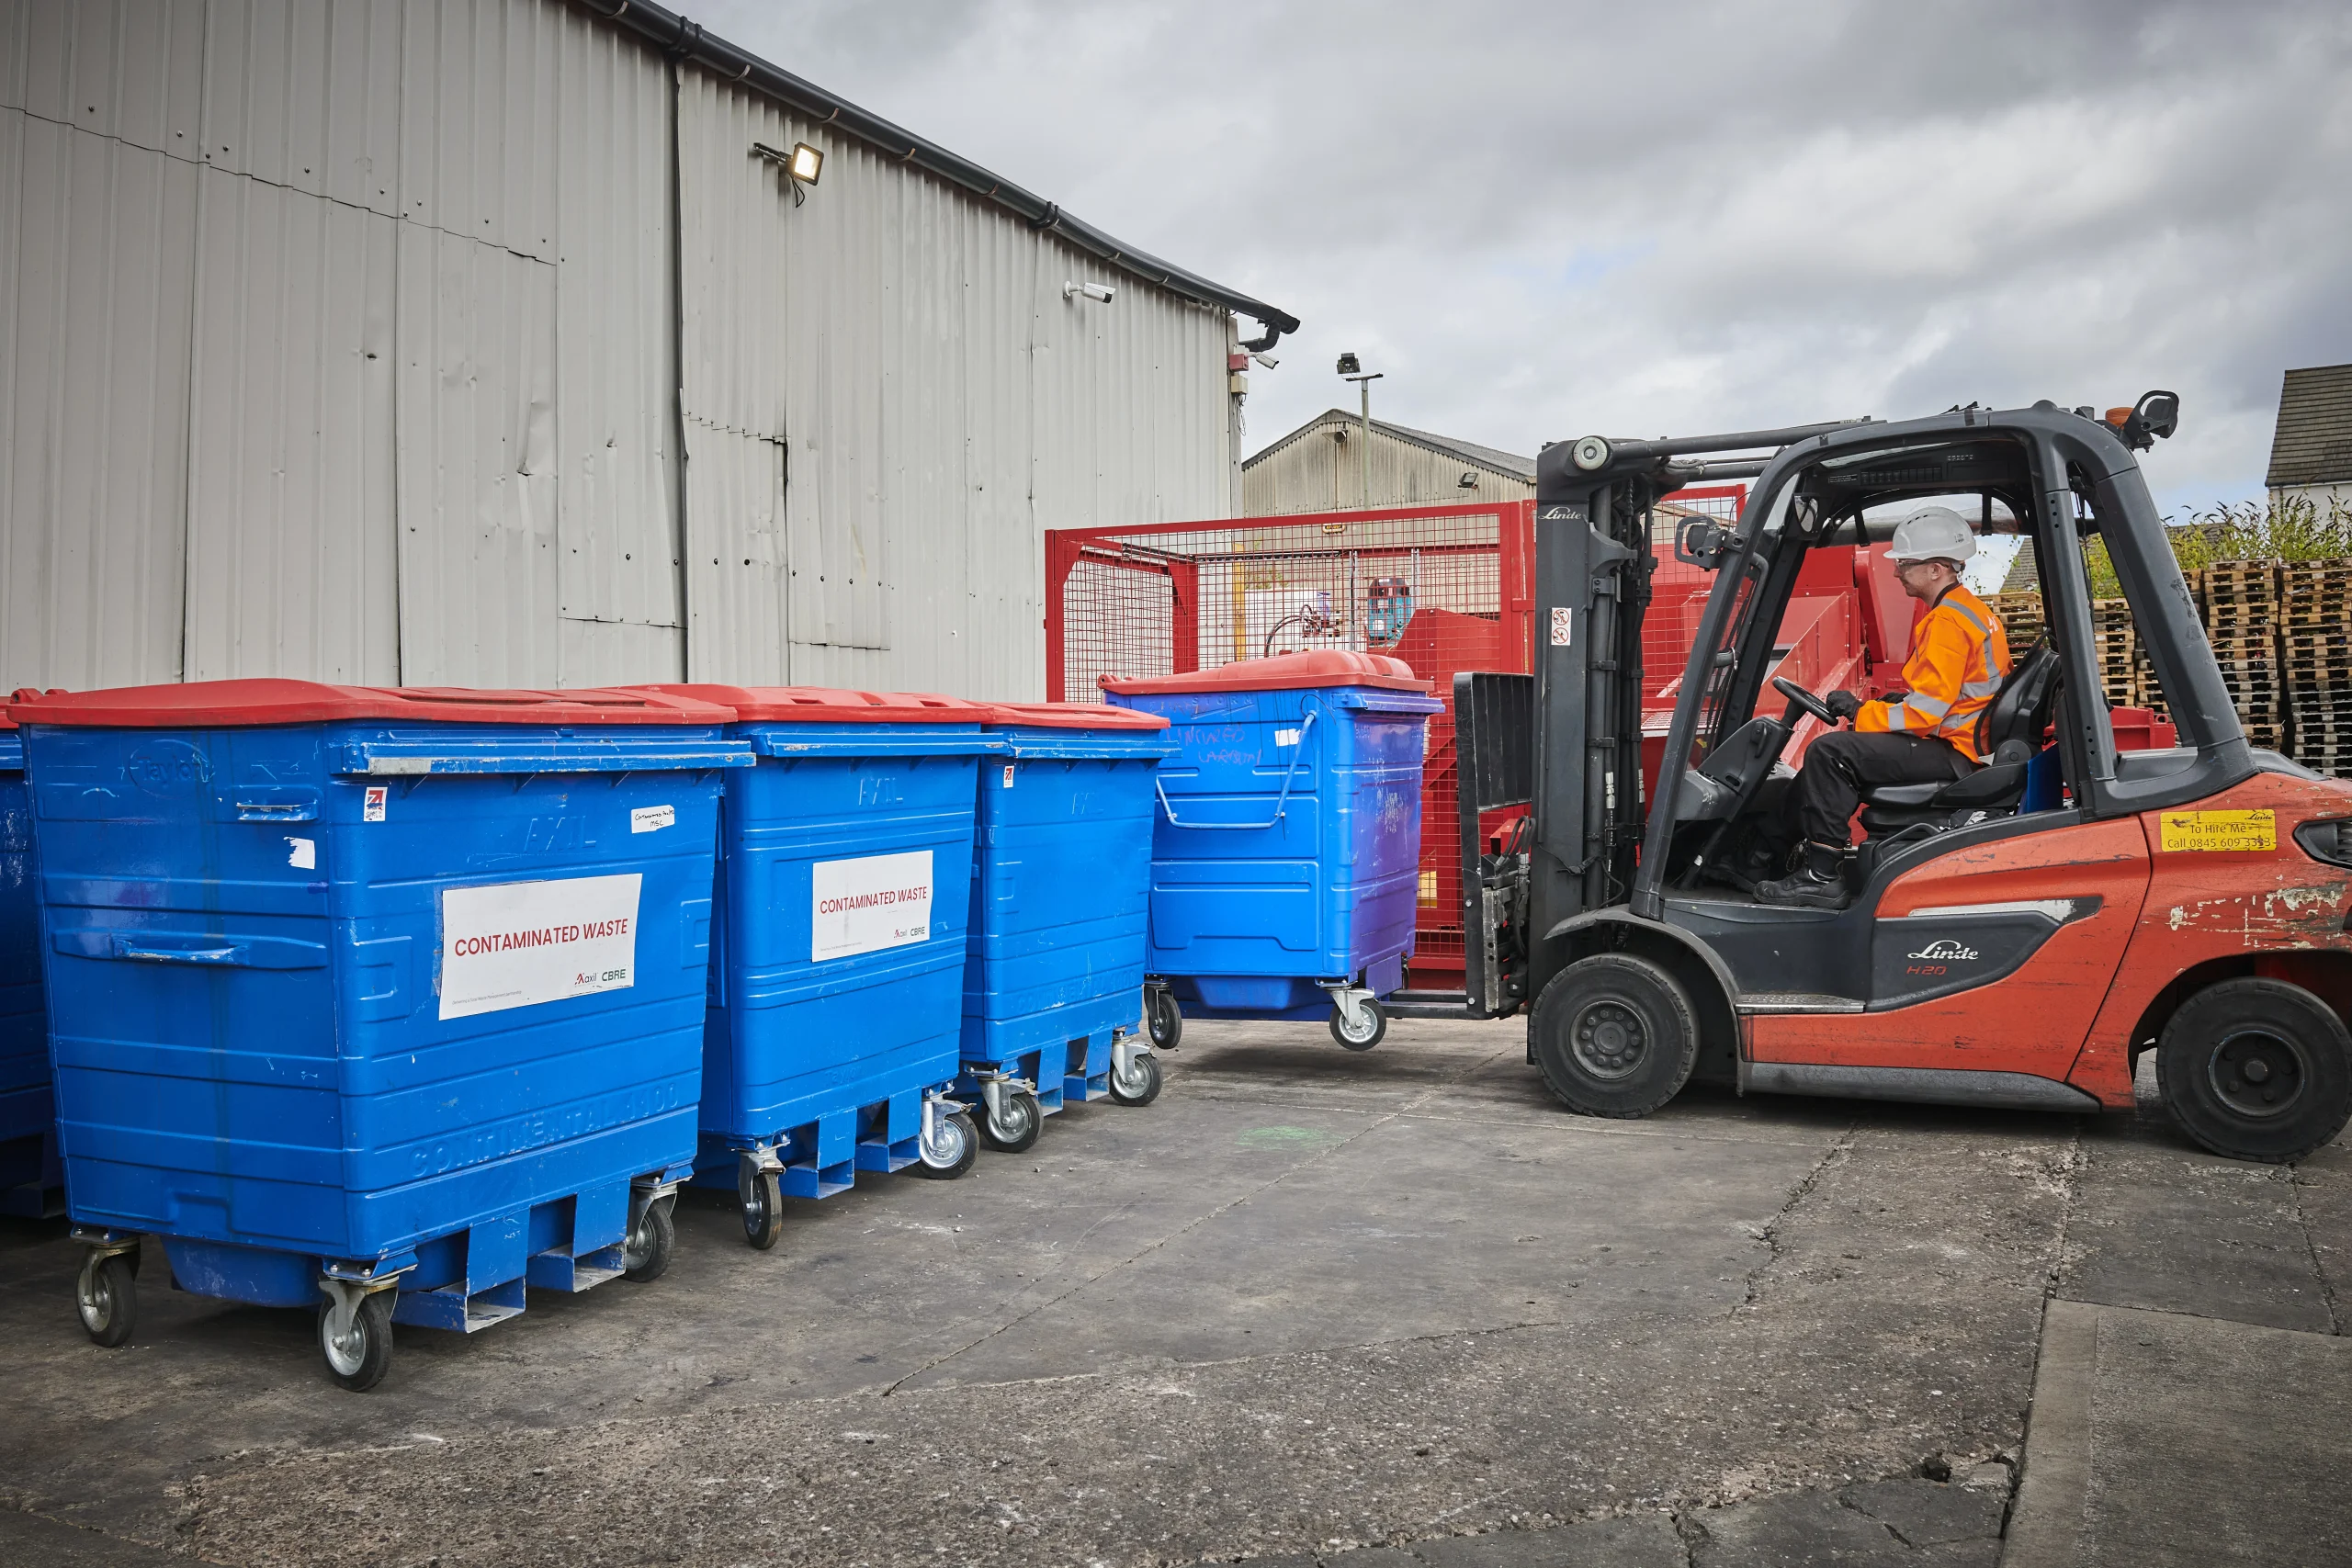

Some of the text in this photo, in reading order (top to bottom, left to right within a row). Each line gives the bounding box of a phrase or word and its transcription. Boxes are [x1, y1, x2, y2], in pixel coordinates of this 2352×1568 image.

[1538, 506, 1581, 520] Linde
[2245, 812, 2273, 821] Linde
[2190, 823, 2246, 834] To Hire Me
[2168, 839, 2186, 848] Call
[2189, 838, 2216, 848] 0845
[2221, 838, 2240, 847] 609
[820, 886, 927, 914] CONTAMINATED WASTE
[455, 919, 628, 957] CONTAMINATED WASTE
[1907, 940, 1979, 960] Linde
[602, 969, 626, 982] CBRE
